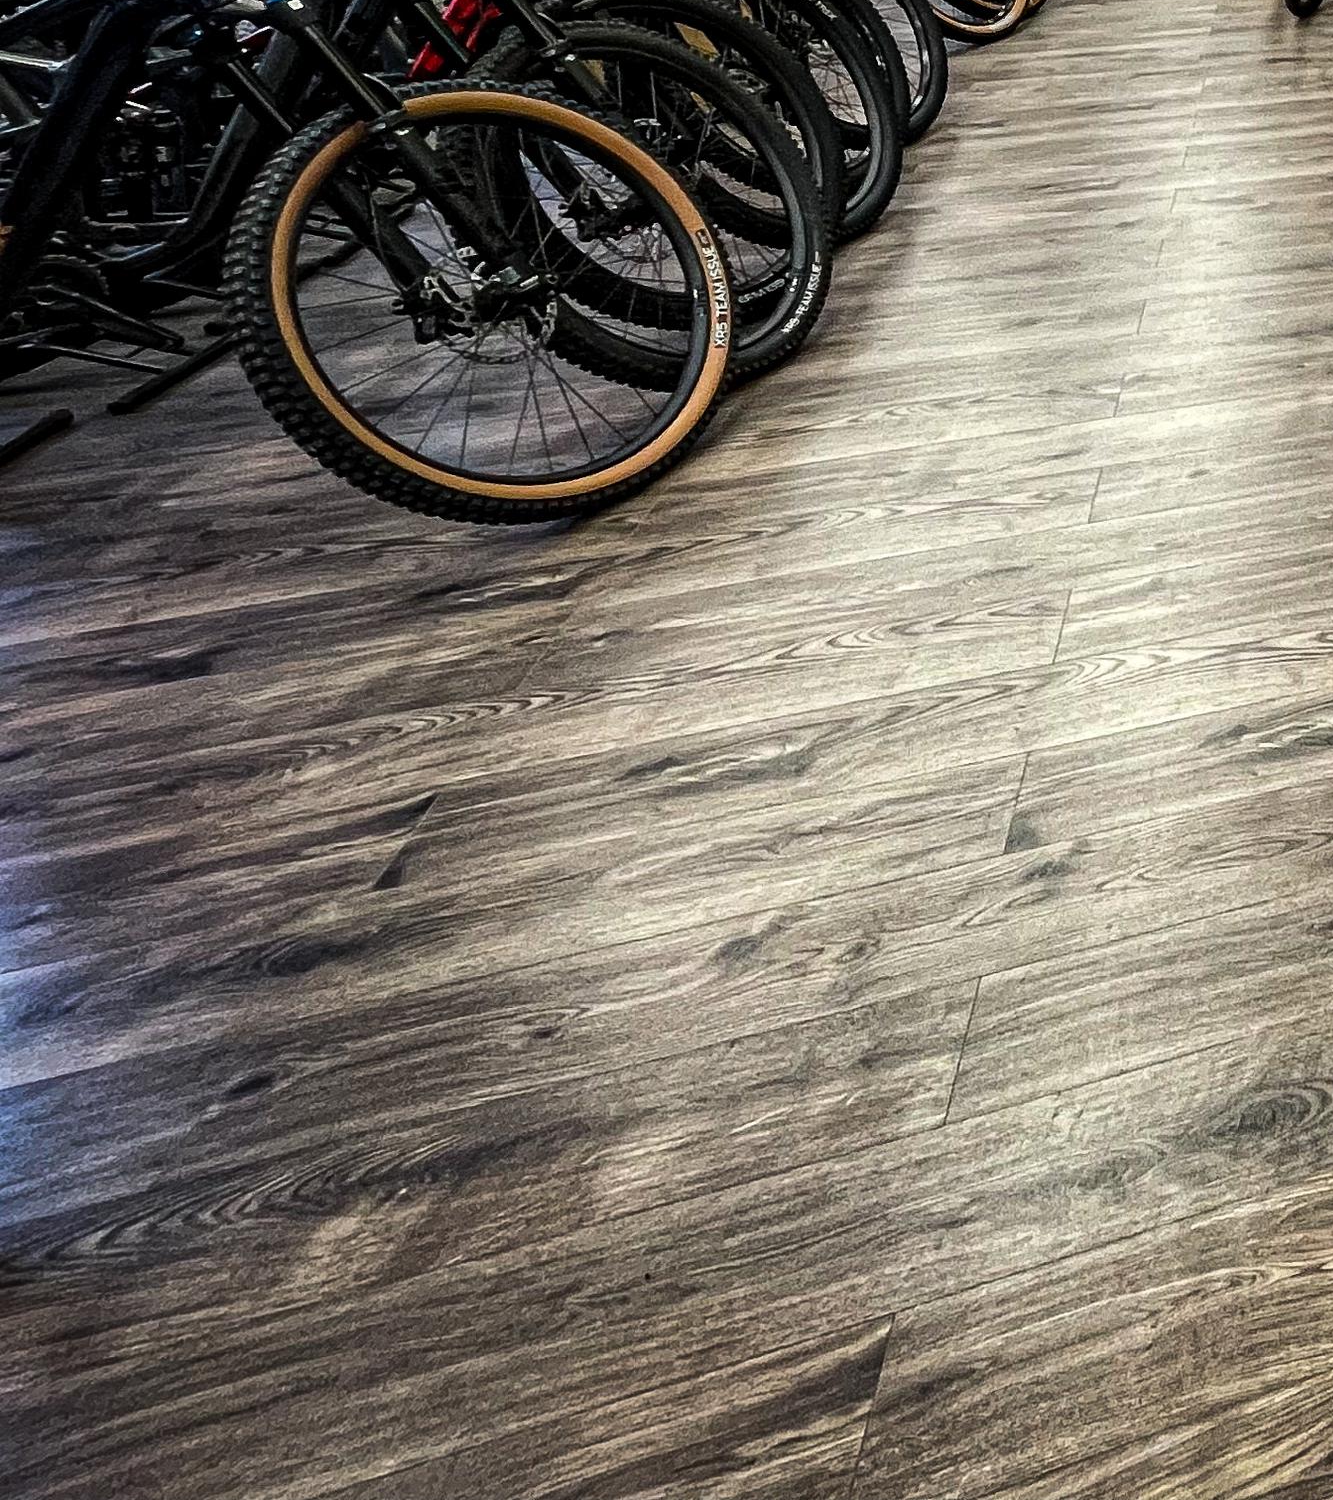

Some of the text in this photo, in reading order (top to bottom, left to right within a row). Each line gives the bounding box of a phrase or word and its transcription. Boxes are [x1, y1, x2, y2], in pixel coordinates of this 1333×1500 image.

[702, 247, 728, 348] XR5 TEAM ISSUE
